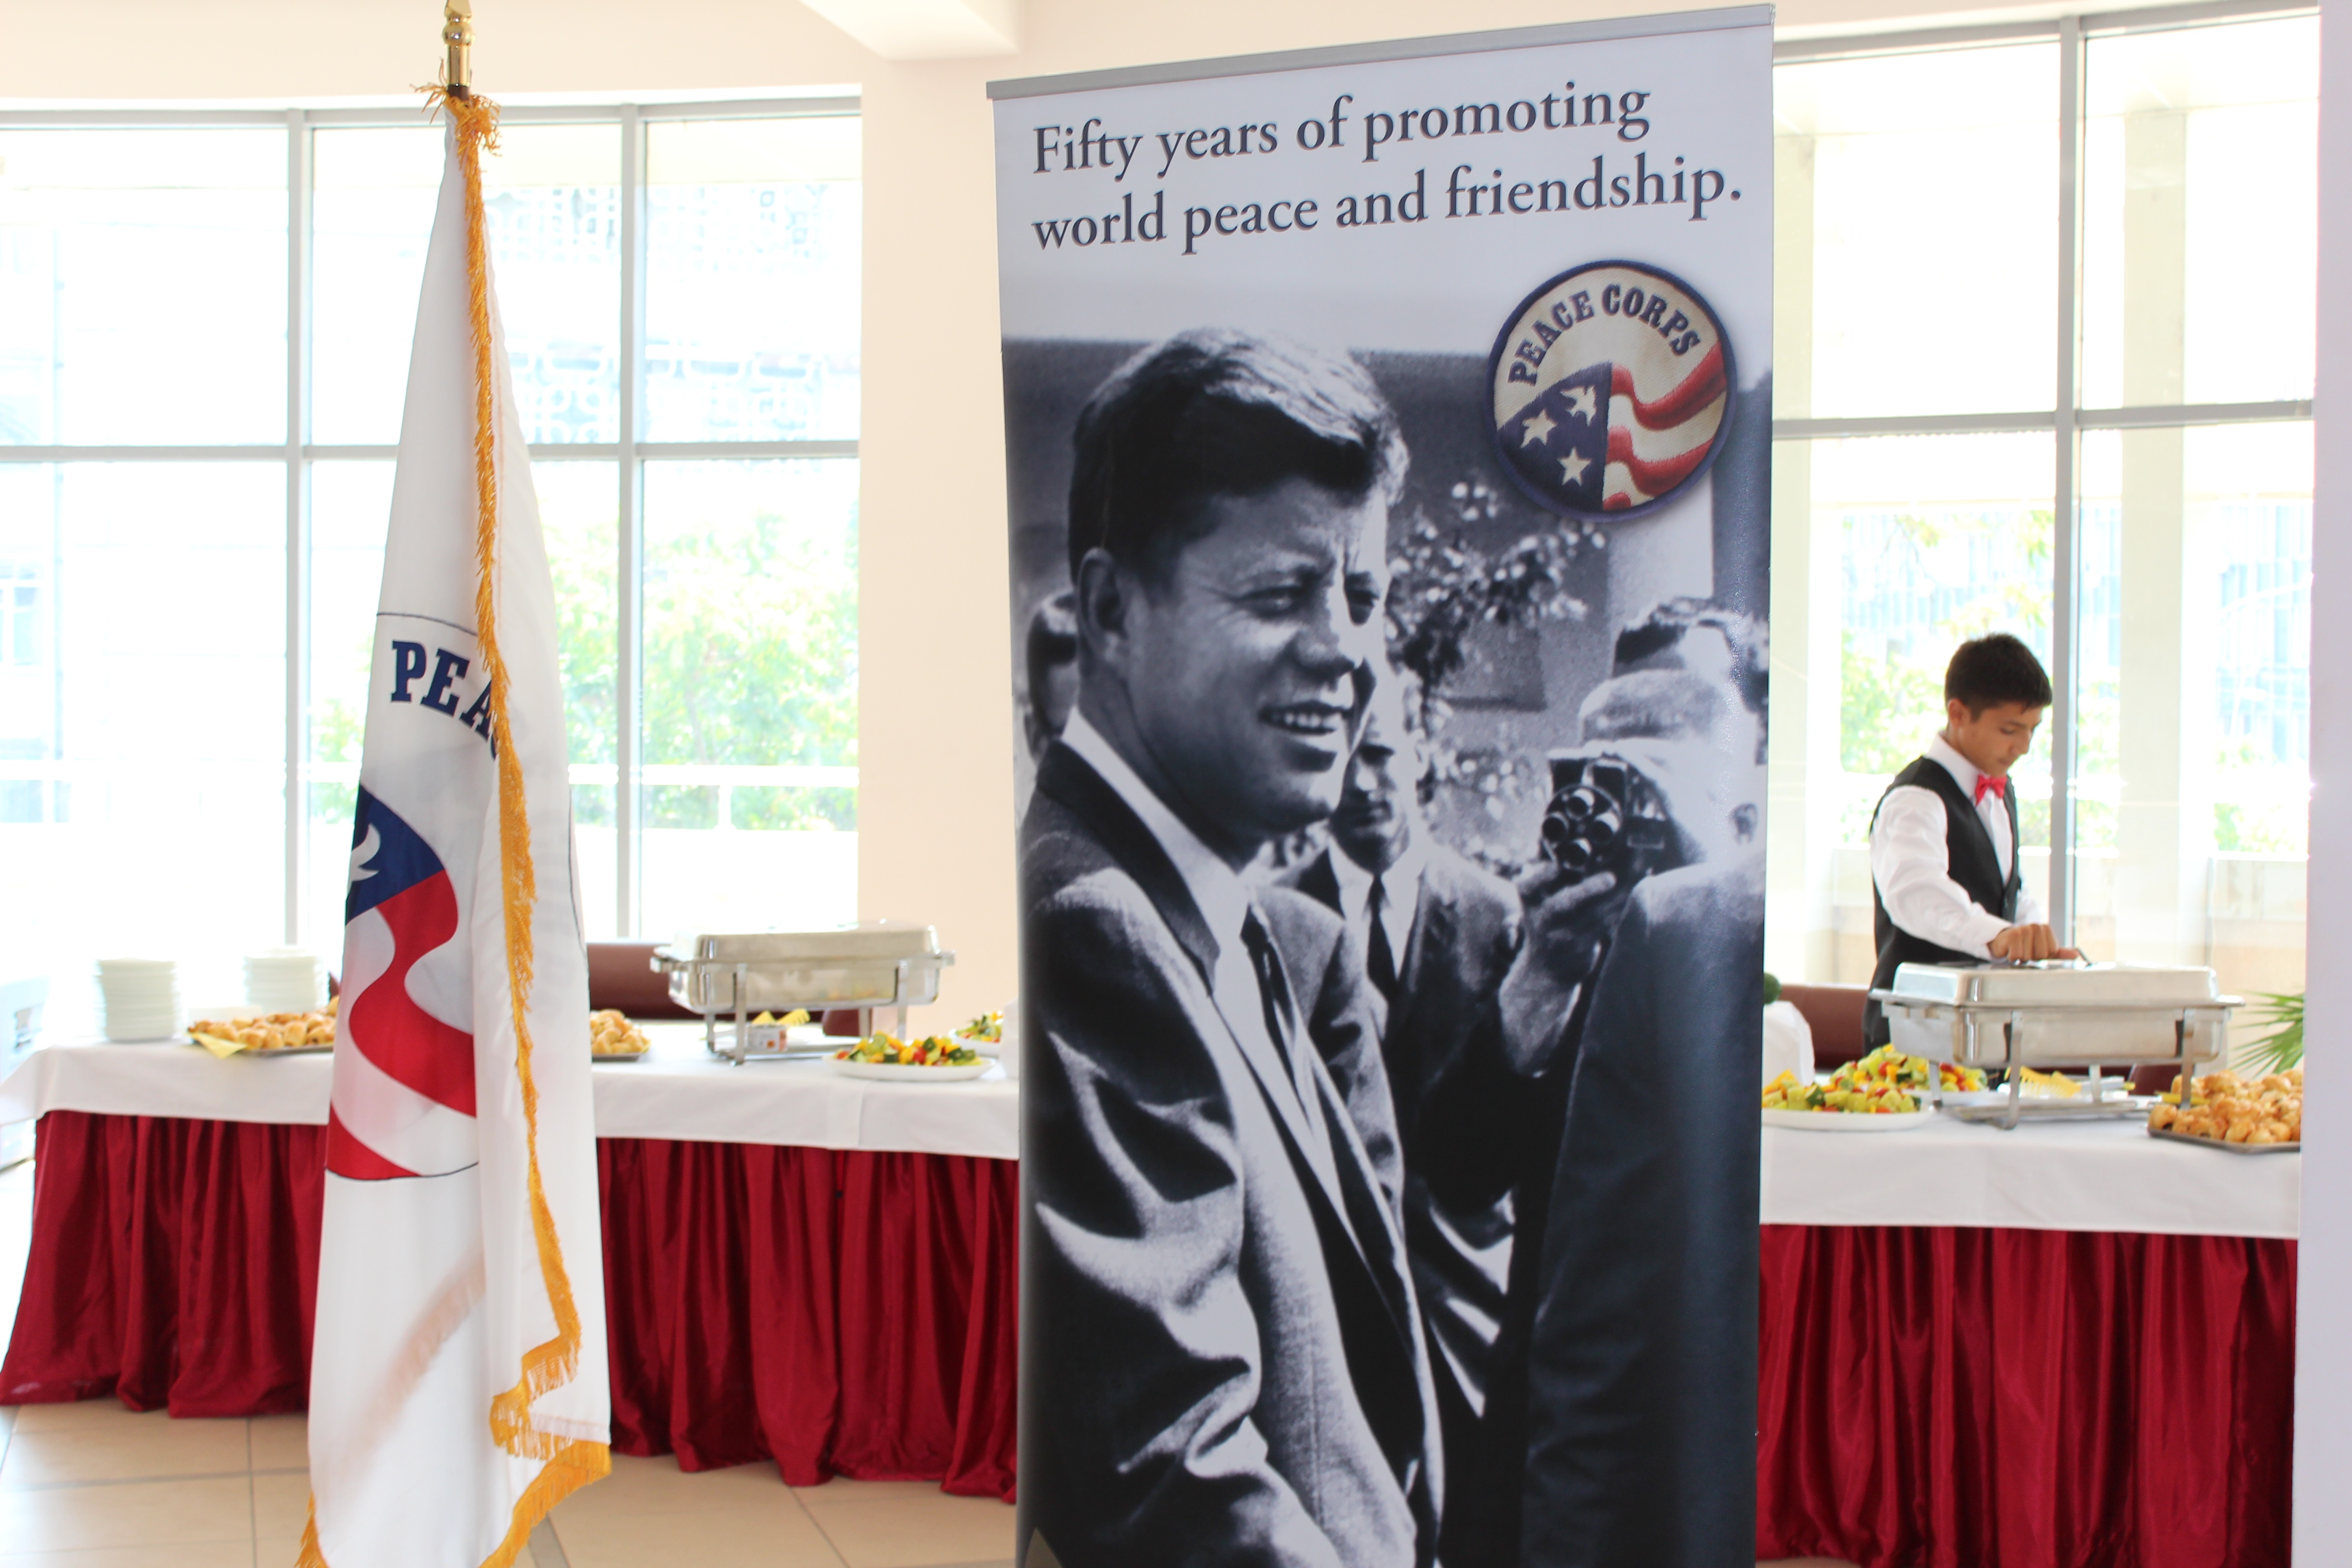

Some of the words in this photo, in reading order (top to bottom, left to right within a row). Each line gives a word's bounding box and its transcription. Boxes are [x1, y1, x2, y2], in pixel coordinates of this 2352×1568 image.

[1032, 118, 1144, 182] Fifty
[1155, 123, 1278, 179] years
[1296, 94, 1353, 150] of
[1362, 81, 1651, 163] promoting
[1031, 192, 1167, 250] world
[1181, 200, 1319, 256] peace
[1336, 168, 1429, 228] and
[1445, 151, 1741, 221] friendship.
[1507, 290, 1595, 387] PEACE
[1601, 283, 1701, 356] CORPS
